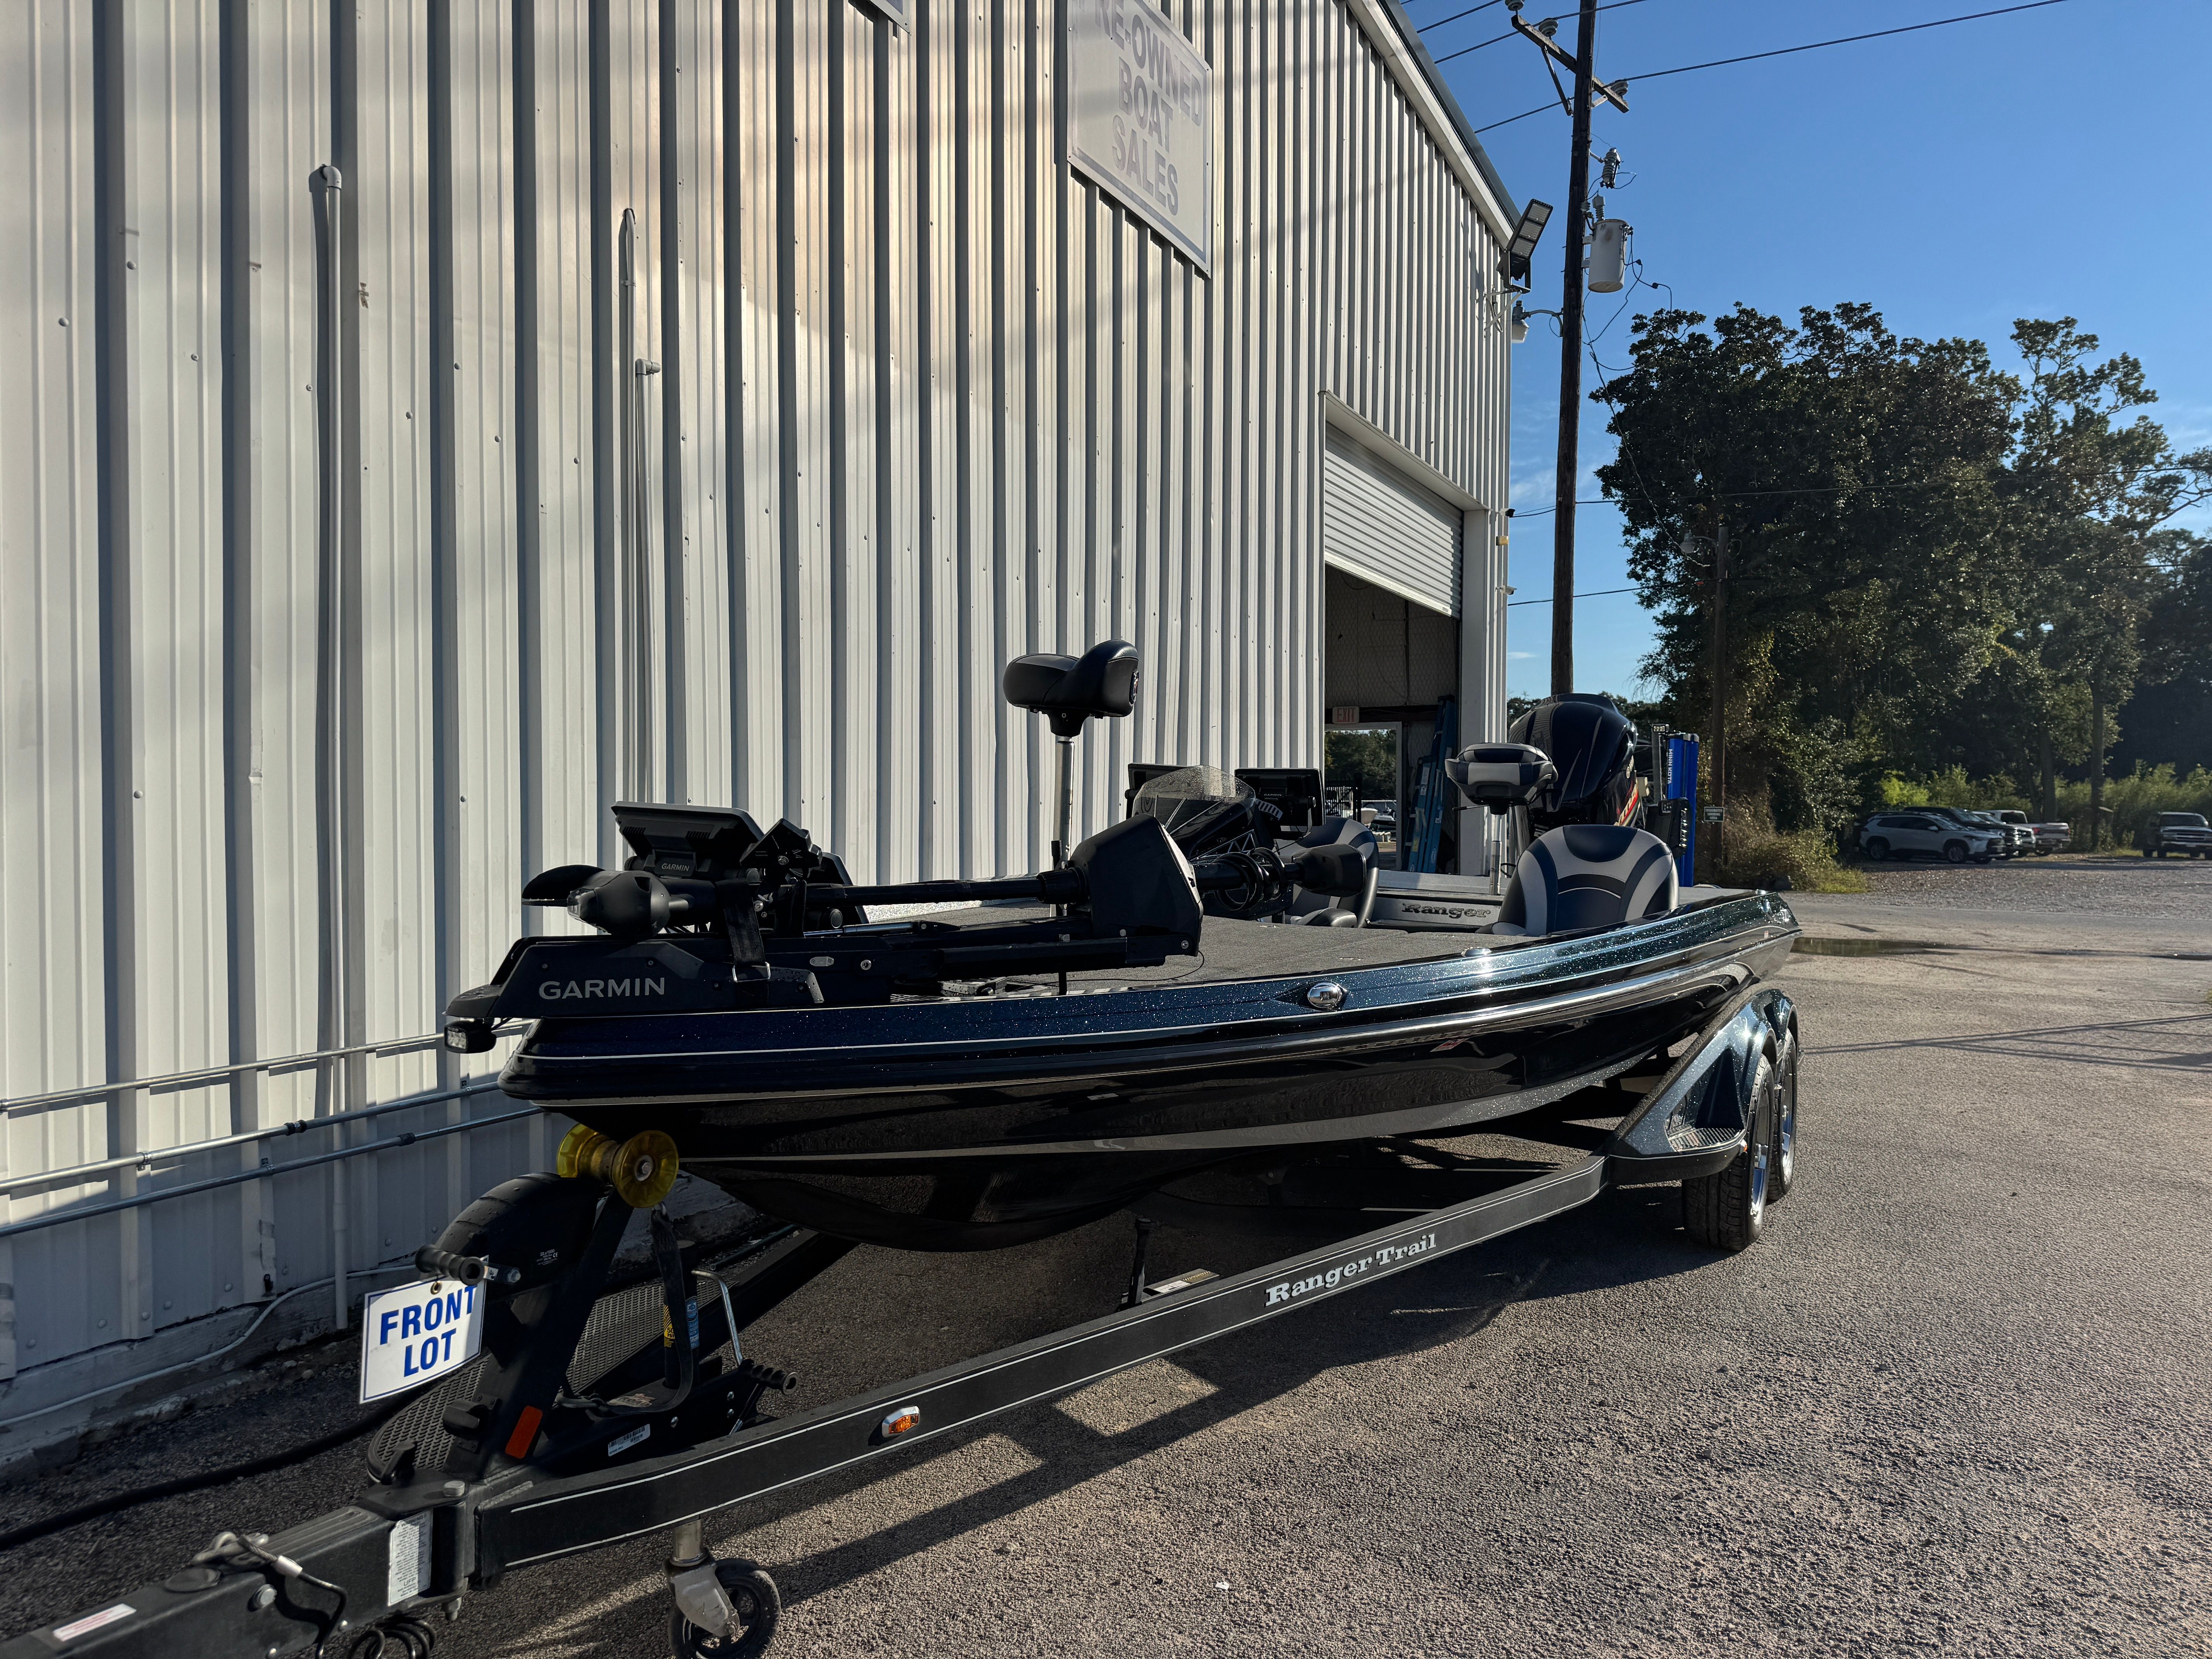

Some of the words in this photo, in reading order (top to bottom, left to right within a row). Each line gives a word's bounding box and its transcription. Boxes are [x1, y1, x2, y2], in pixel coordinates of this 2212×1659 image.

[1079, 0, 1202, 127] RE-OWNED
[1119, 57, 1173, 153] BOAT
[1112, 115, 1178, 216] SALES
[1337, 707, 1355, 722] EXIT
[661, 863, 690, 871] GARMIN
[1401, 903, 1491, 919] Ranger
[539, 977, 665, 1000] GARMIN
[1264, 1256, 1372, 1307] Ranger
[1375, 1233, 1436, 1266] Trail
[380, 1285, 477, 1345] FRONT
[404, 1328, 457, 1377] LOT
[404, 1577, 416, 1586] UFP
